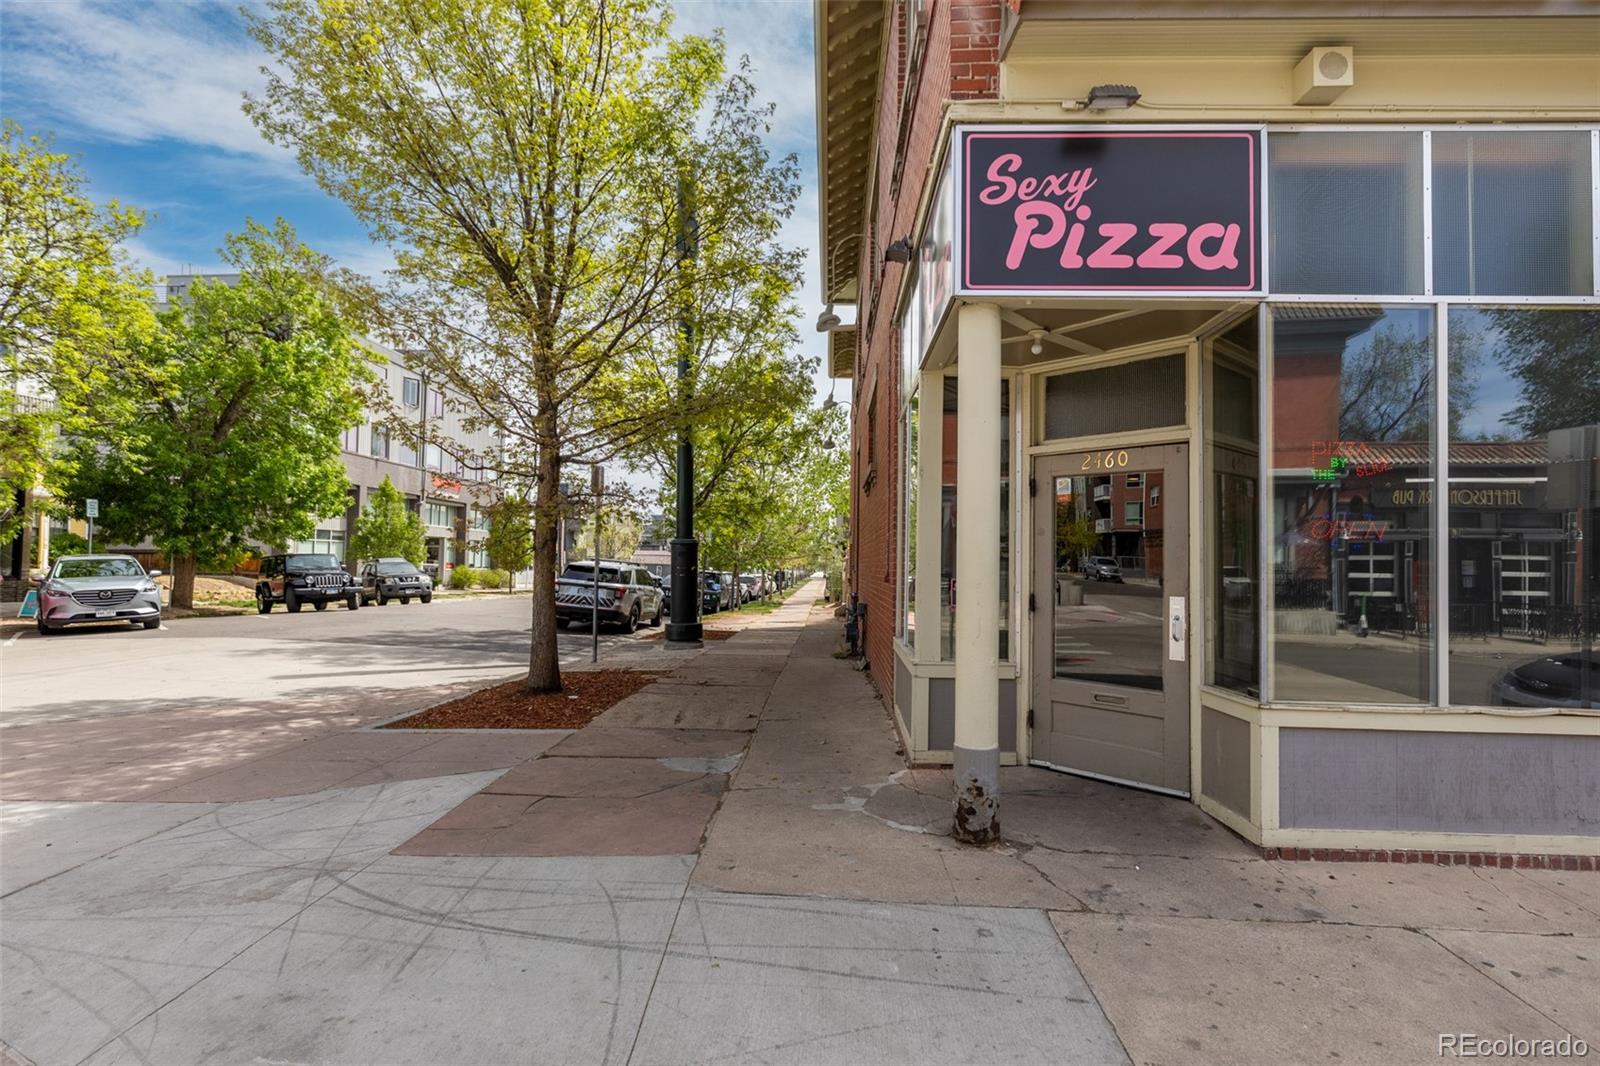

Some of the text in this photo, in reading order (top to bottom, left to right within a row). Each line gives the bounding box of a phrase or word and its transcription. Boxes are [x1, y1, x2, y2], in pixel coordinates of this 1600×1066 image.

[979, 153, 1098, 212] Sexy
[1005, 200, 1241, 271] Pizza
[1311, 469, 1336, 480] THE
[1330, 457, 1348, 469] BY
